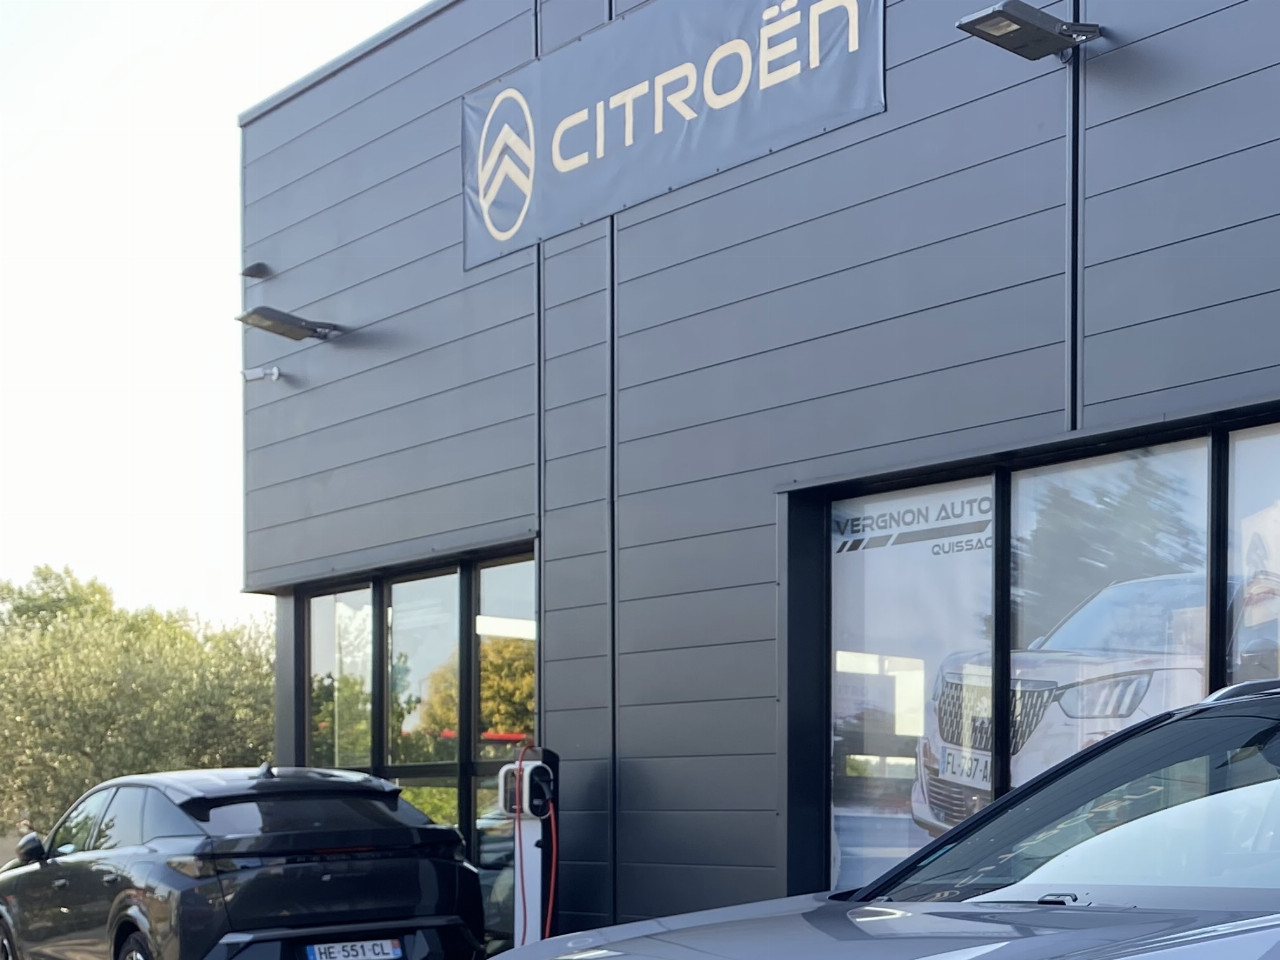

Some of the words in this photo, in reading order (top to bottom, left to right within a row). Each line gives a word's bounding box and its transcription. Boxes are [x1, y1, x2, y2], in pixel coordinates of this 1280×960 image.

[835, 506, 929, 536] VERGNON
[935, 496, 993, 521] AUTO
[946, 752, 992, 783] FL-797-A
